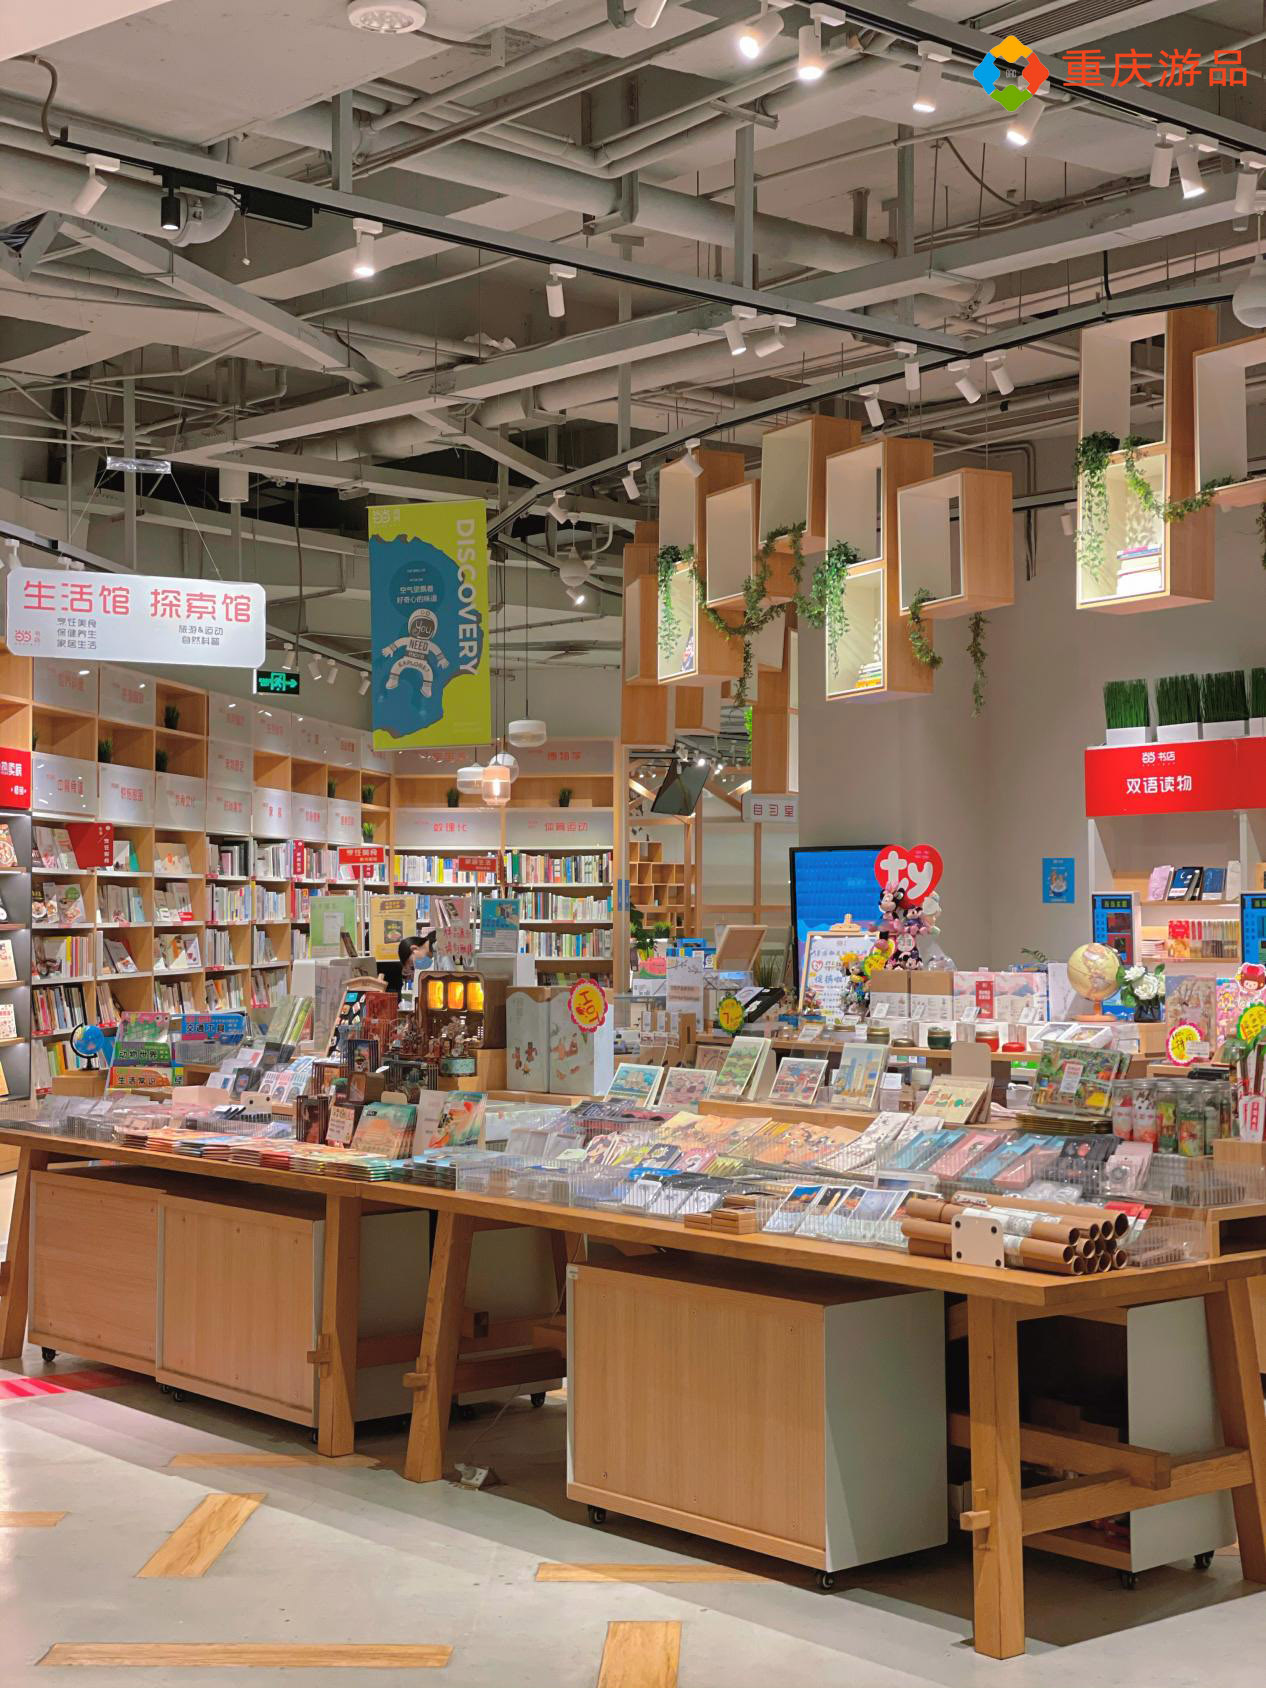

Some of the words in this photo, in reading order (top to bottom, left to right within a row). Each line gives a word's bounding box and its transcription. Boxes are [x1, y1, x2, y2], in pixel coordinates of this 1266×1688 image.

[23, 580, 130, 615] 生活馆
[150, 589, 251, 623] 探索馆
[455, 518, 479, 676] DISCOVERY
[56, 628, 97, 639] 保健养生
[56, 639, 97, 650] 家居生活
[409, 639, 429, 652] NEED
[1157, 751, 1176, 762] 书店
[1126, 775, 1193, 794] 双语读物
[880, 850, 934, 900] ty
[186, 1023, 226, 1033] 交通工具
[120, 1049, 158, 1059] 动物世界
